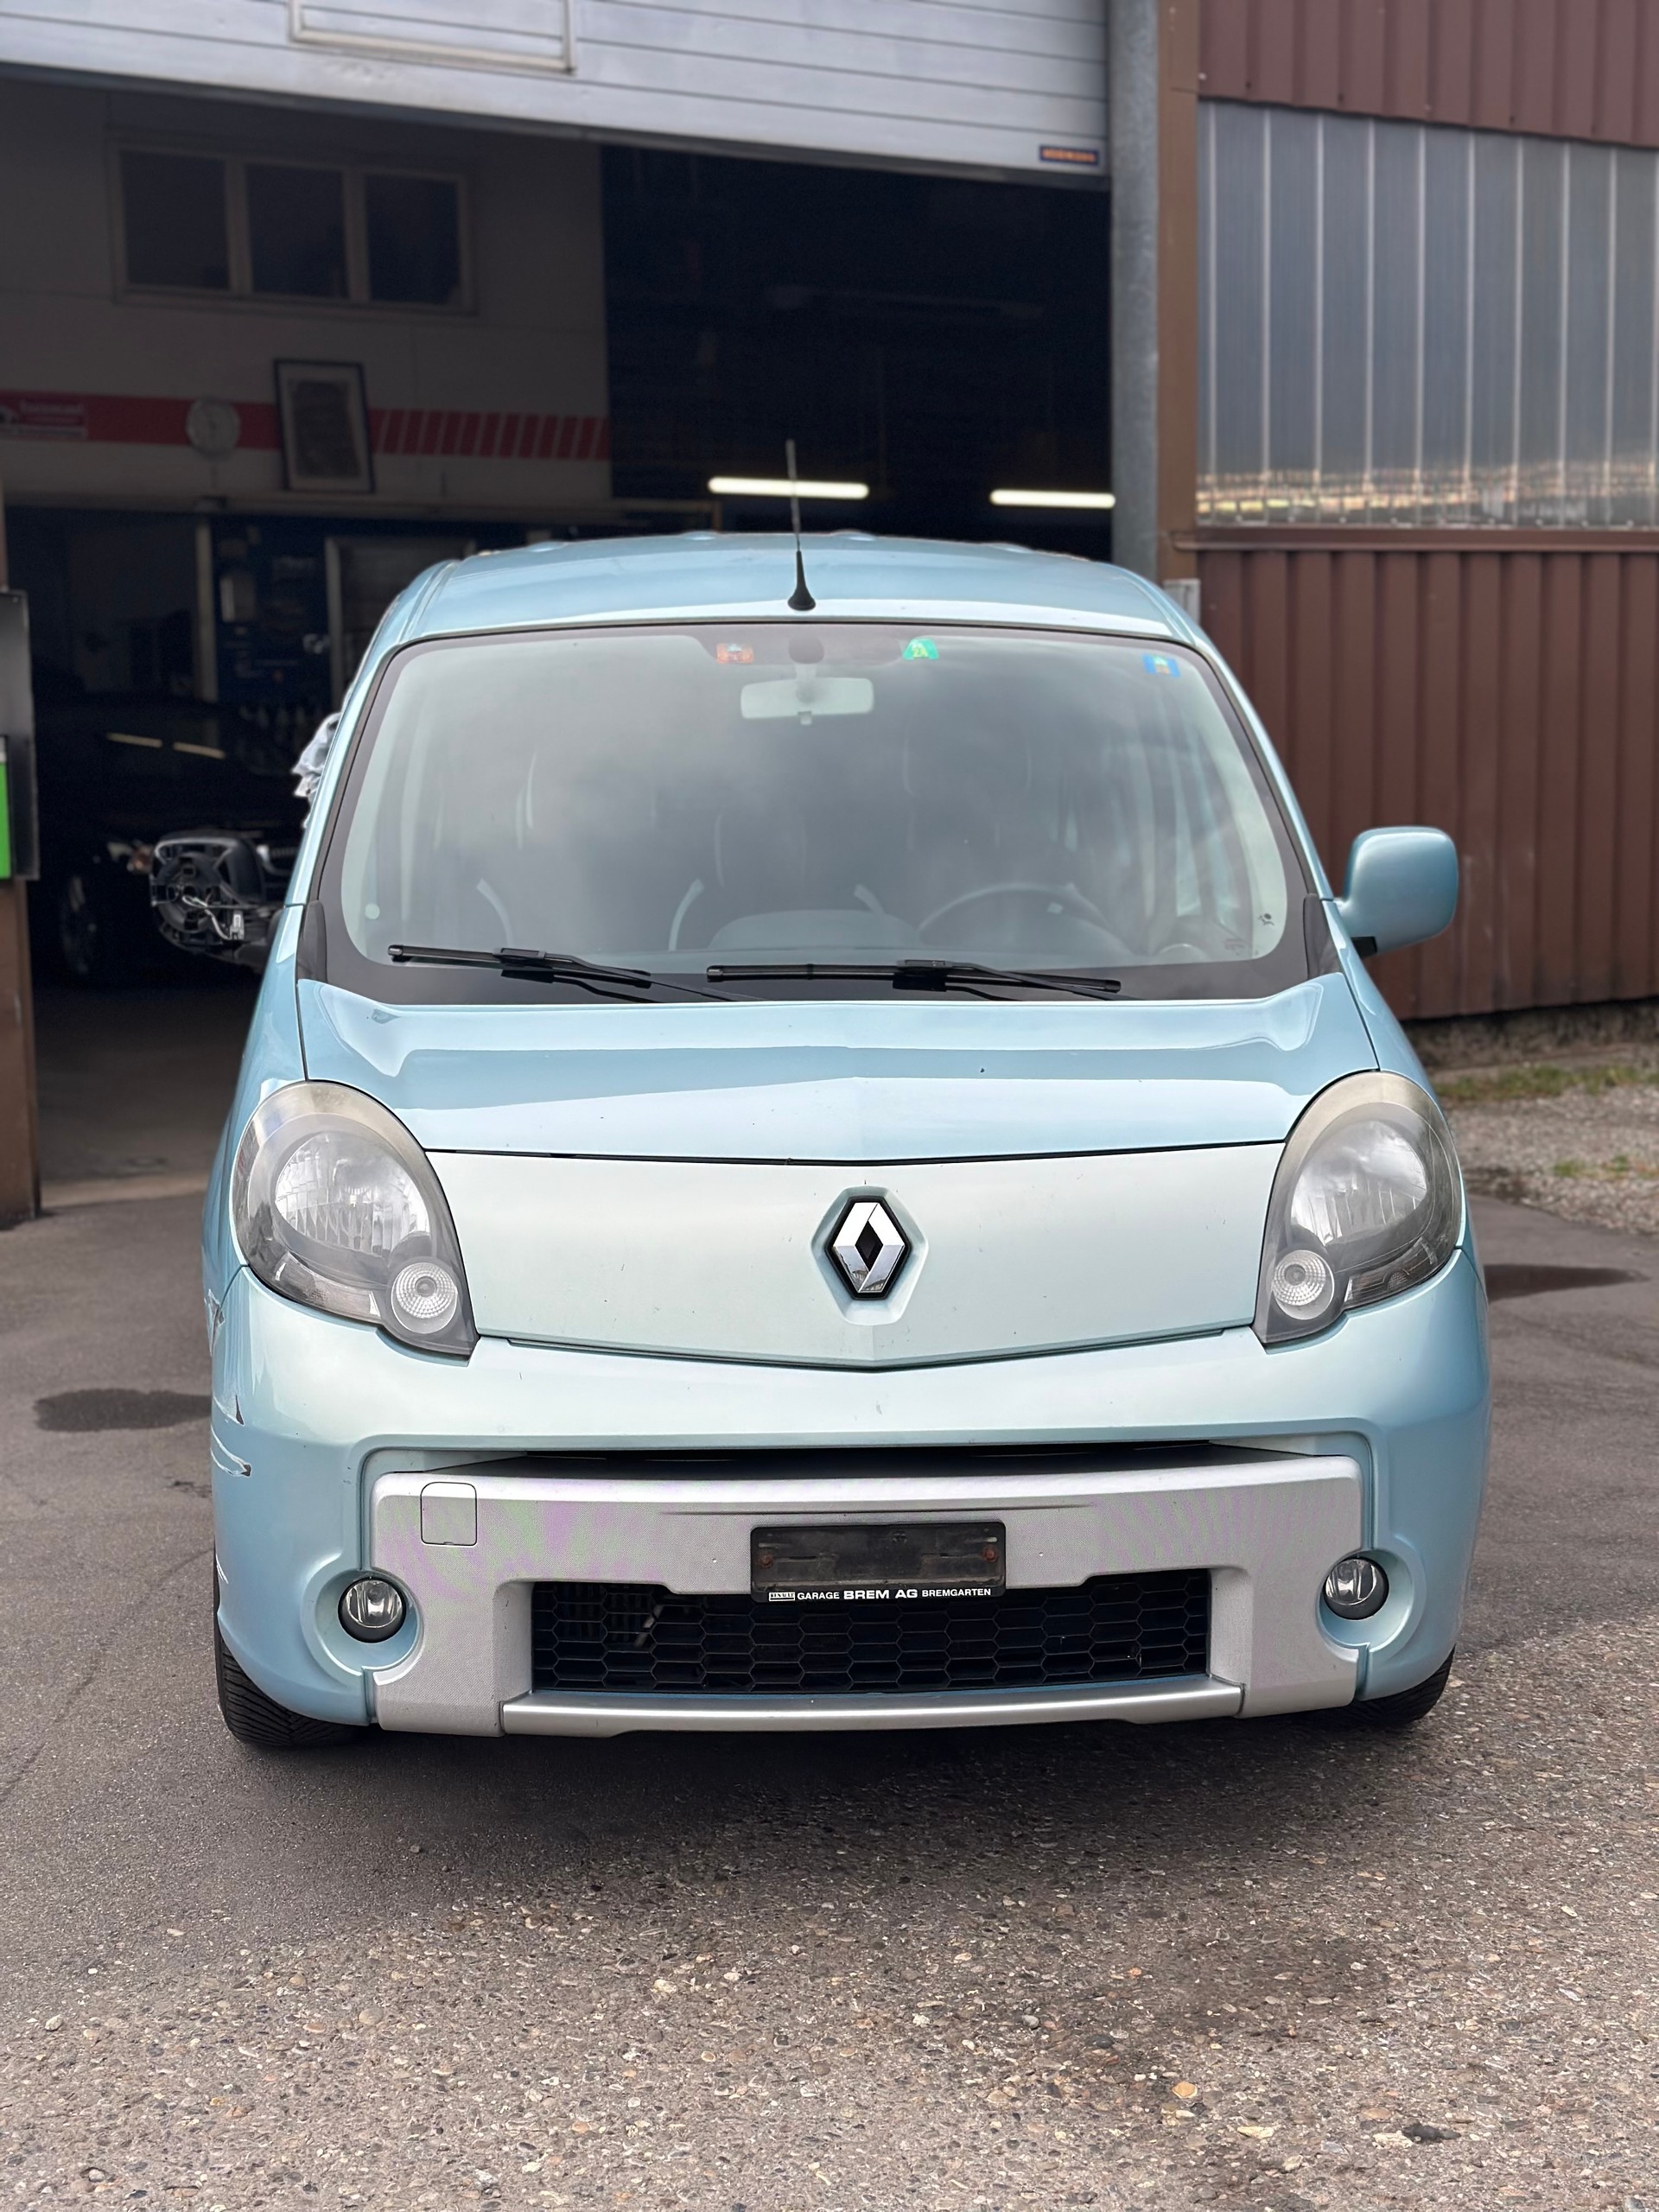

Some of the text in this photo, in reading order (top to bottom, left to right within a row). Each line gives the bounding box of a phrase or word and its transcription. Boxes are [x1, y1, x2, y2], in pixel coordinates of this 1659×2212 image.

[797, 1592, 840, 1600] GARAGE
[843, 1590, 890, 1600] BREM
[894, 1588, 918, 1599] AG
[921, 1588, 991, 1598] BREMGARTEN
